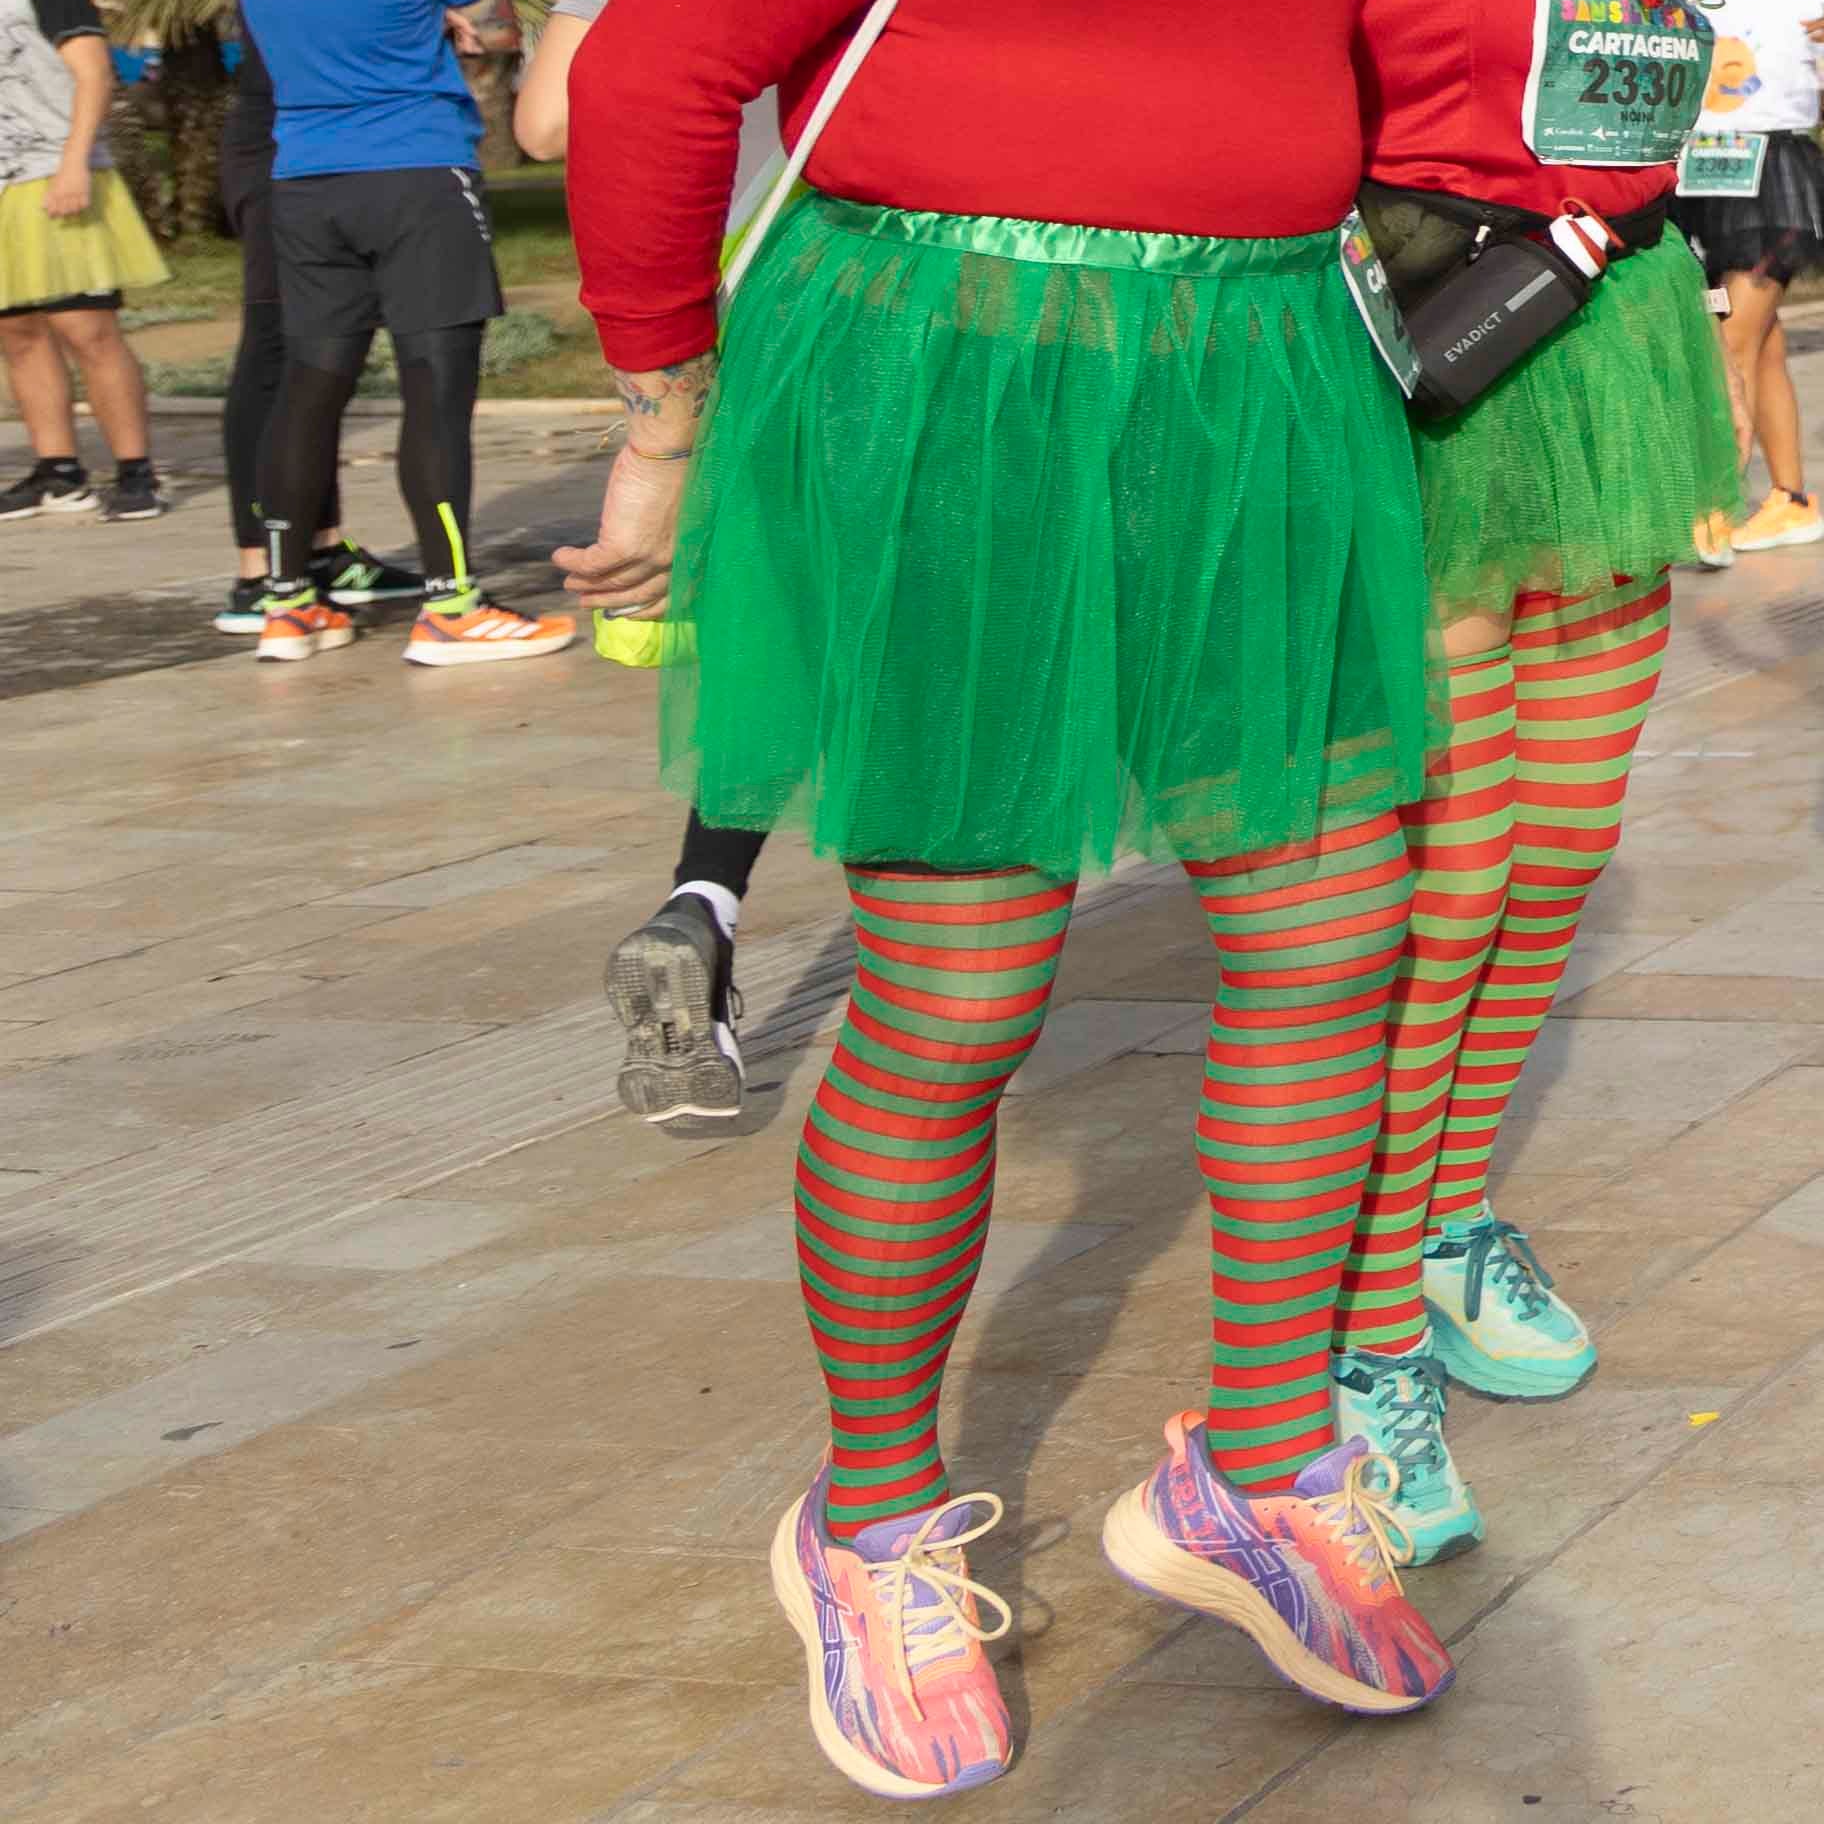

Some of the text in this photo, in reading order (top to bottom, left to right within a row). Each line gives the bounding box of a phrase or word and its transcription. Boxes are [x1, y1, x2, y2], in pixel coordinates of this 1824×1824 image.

[1560, 0, 1606, 23] SAN
[1568, 29, 1700, 62] CARTAGENA
[1578, 57, 1688, 108] 2330
